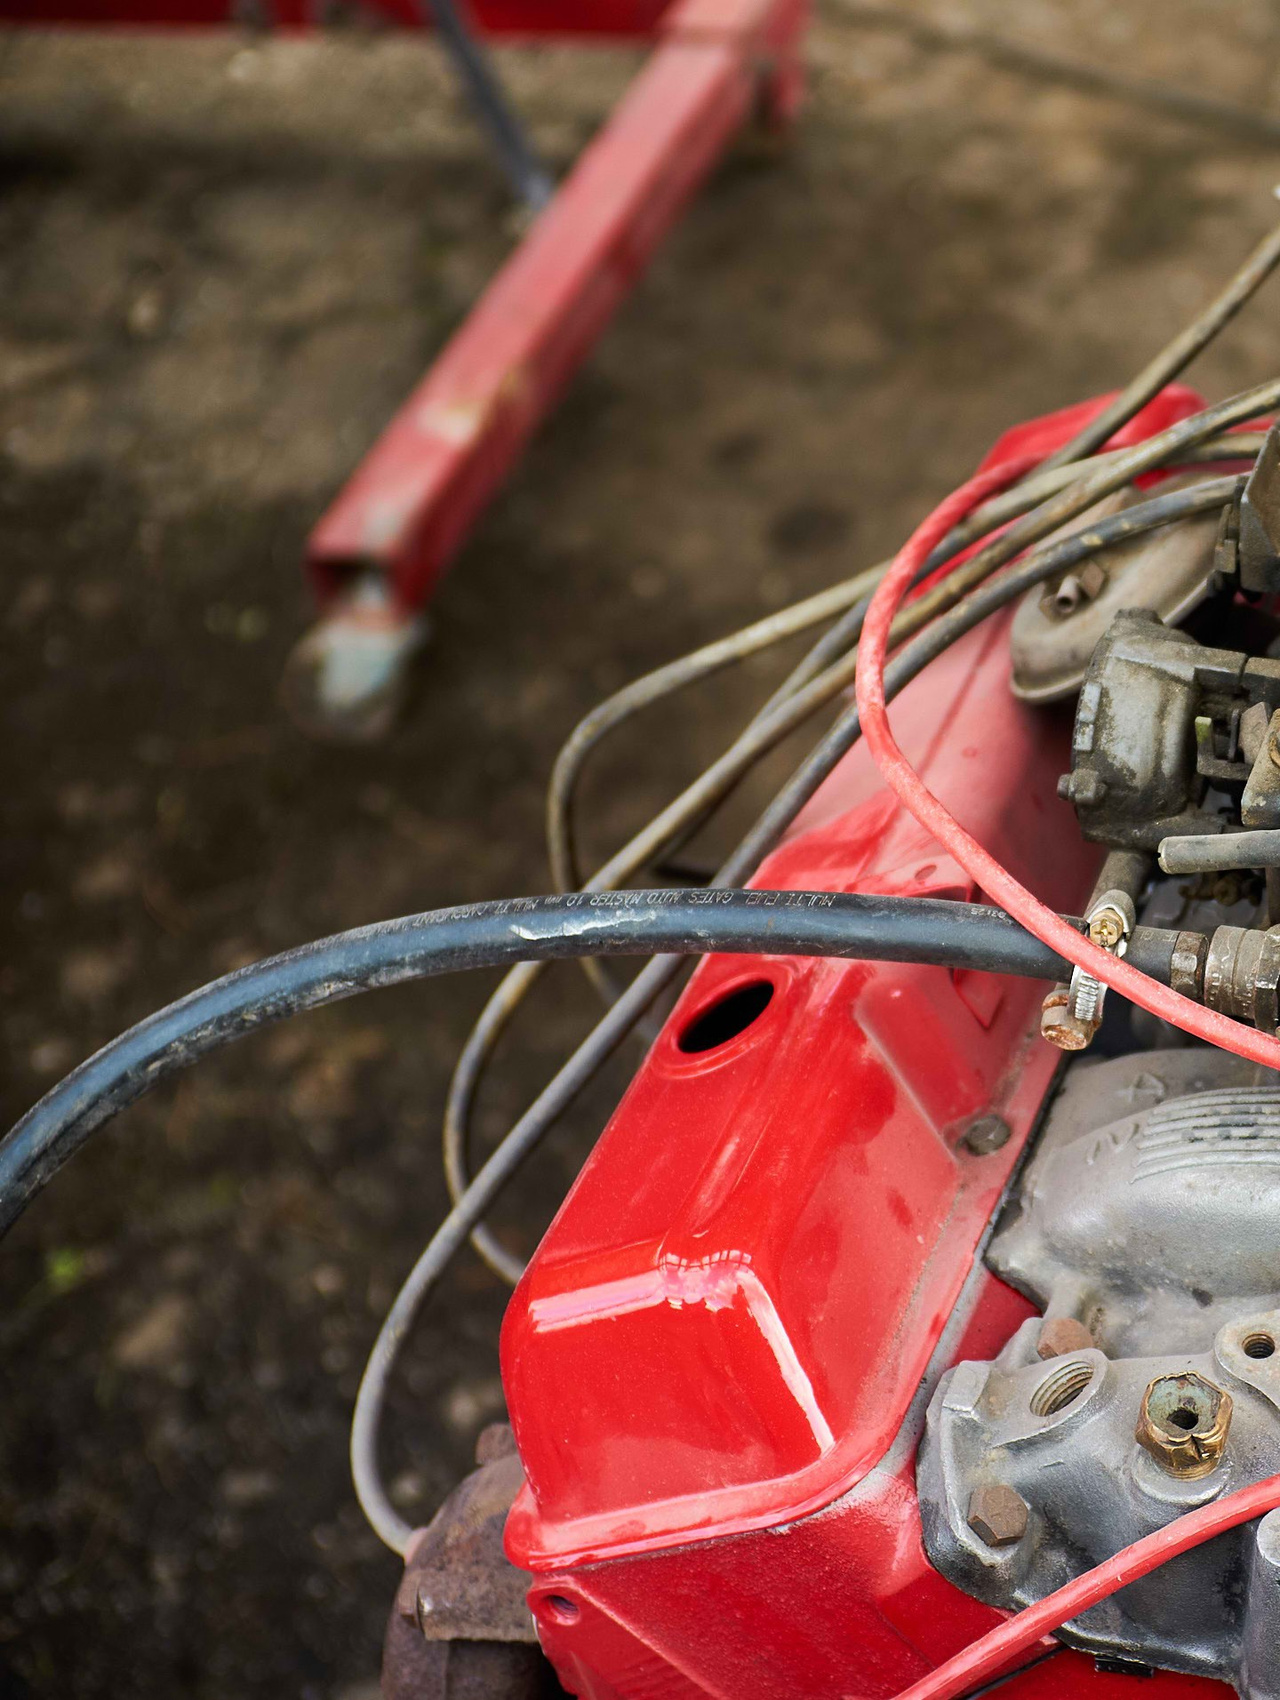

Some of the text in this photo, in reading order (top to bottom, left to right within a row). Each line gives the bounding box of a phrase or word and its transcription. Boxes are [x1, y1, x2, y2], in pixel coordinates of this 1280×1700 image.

[566, 896, 583, 907] 10
[590, 890, 643, 908] MASTER
[647, 891, 684, 905] AUTO
[688, 891, 735, 905] GATES
[743, 891, 780, 906] FUEL
[785, 892, 837, 907] MULTI
